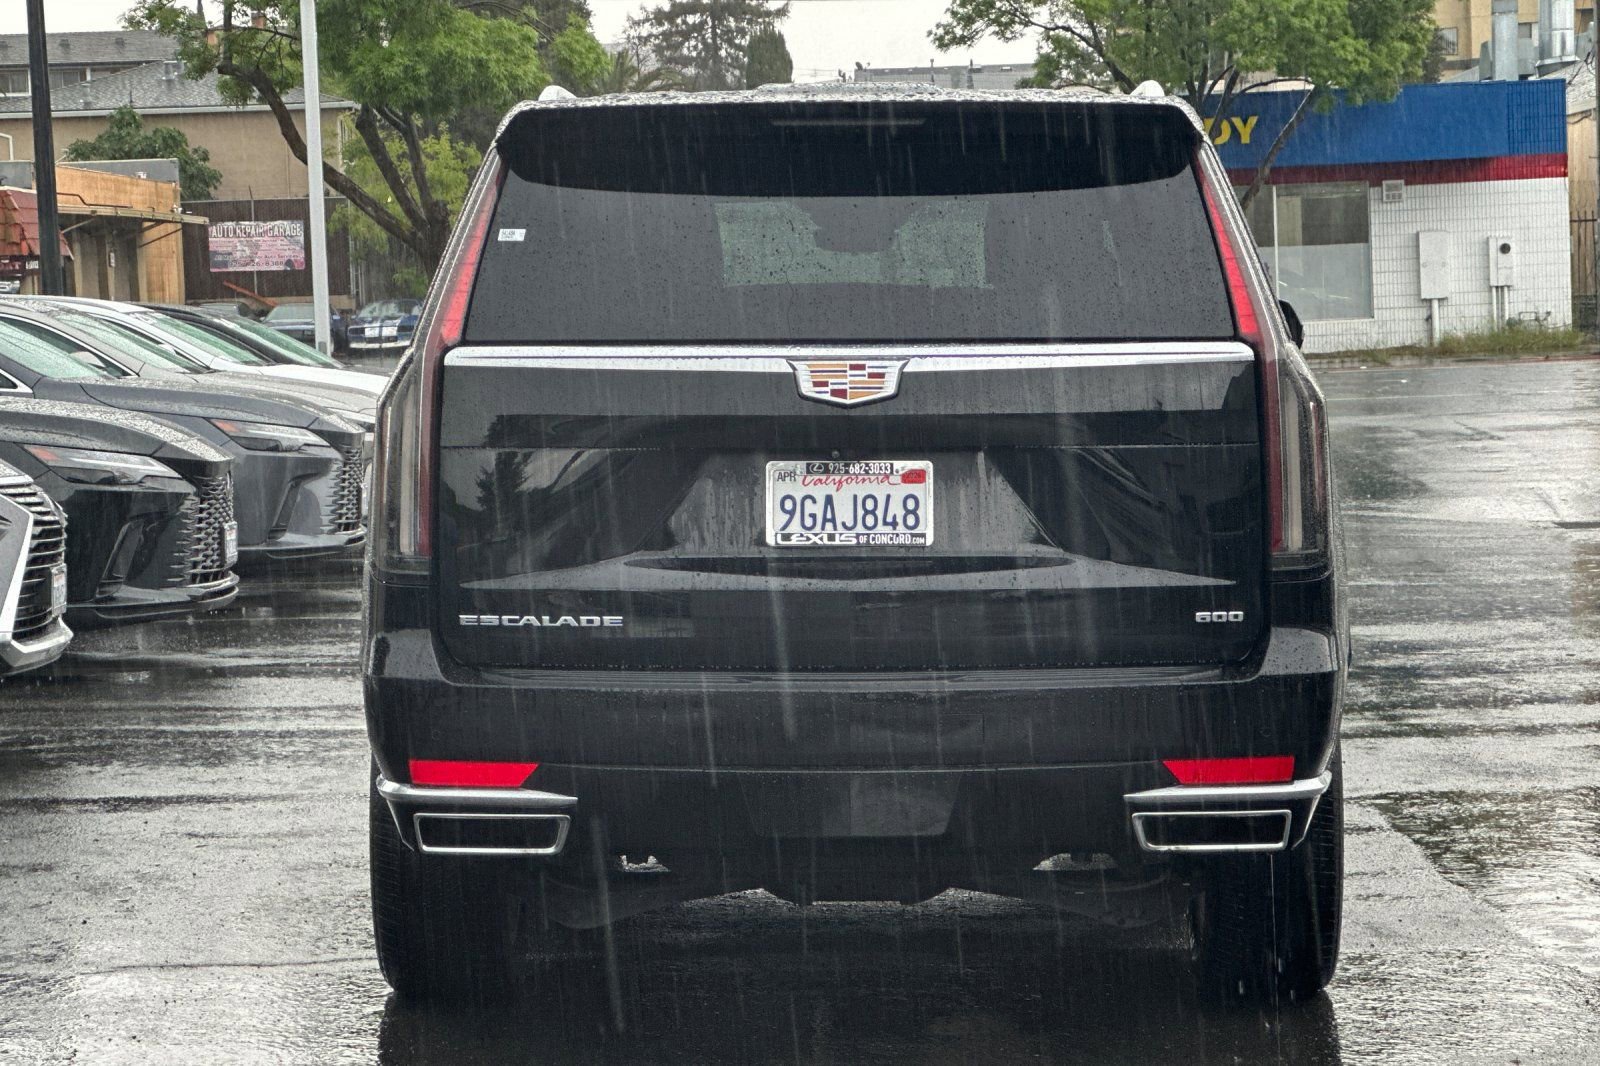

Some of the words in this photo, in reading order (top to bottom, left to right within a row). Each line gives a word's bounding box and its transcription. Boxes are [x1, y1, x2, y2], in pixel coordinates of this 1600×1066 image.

[211, 225, 234, 238] AUTO
[236, 224, 265, 238] REPAIR
[267, 223, 302, 237] GARAGE
[828, 462, 891, 475] 925-682-3033
[777, 471, 796, 482] APR
[801, 474, 901, 492] California
[779, 493, 921, 532] 9GAJ848
[776, 533, 858, 546] LEXUS
[859, 535, 868, 544] OF
[459, 614, 624, 627] ESCALADE
[1195, 611, 1244, 623] 600
